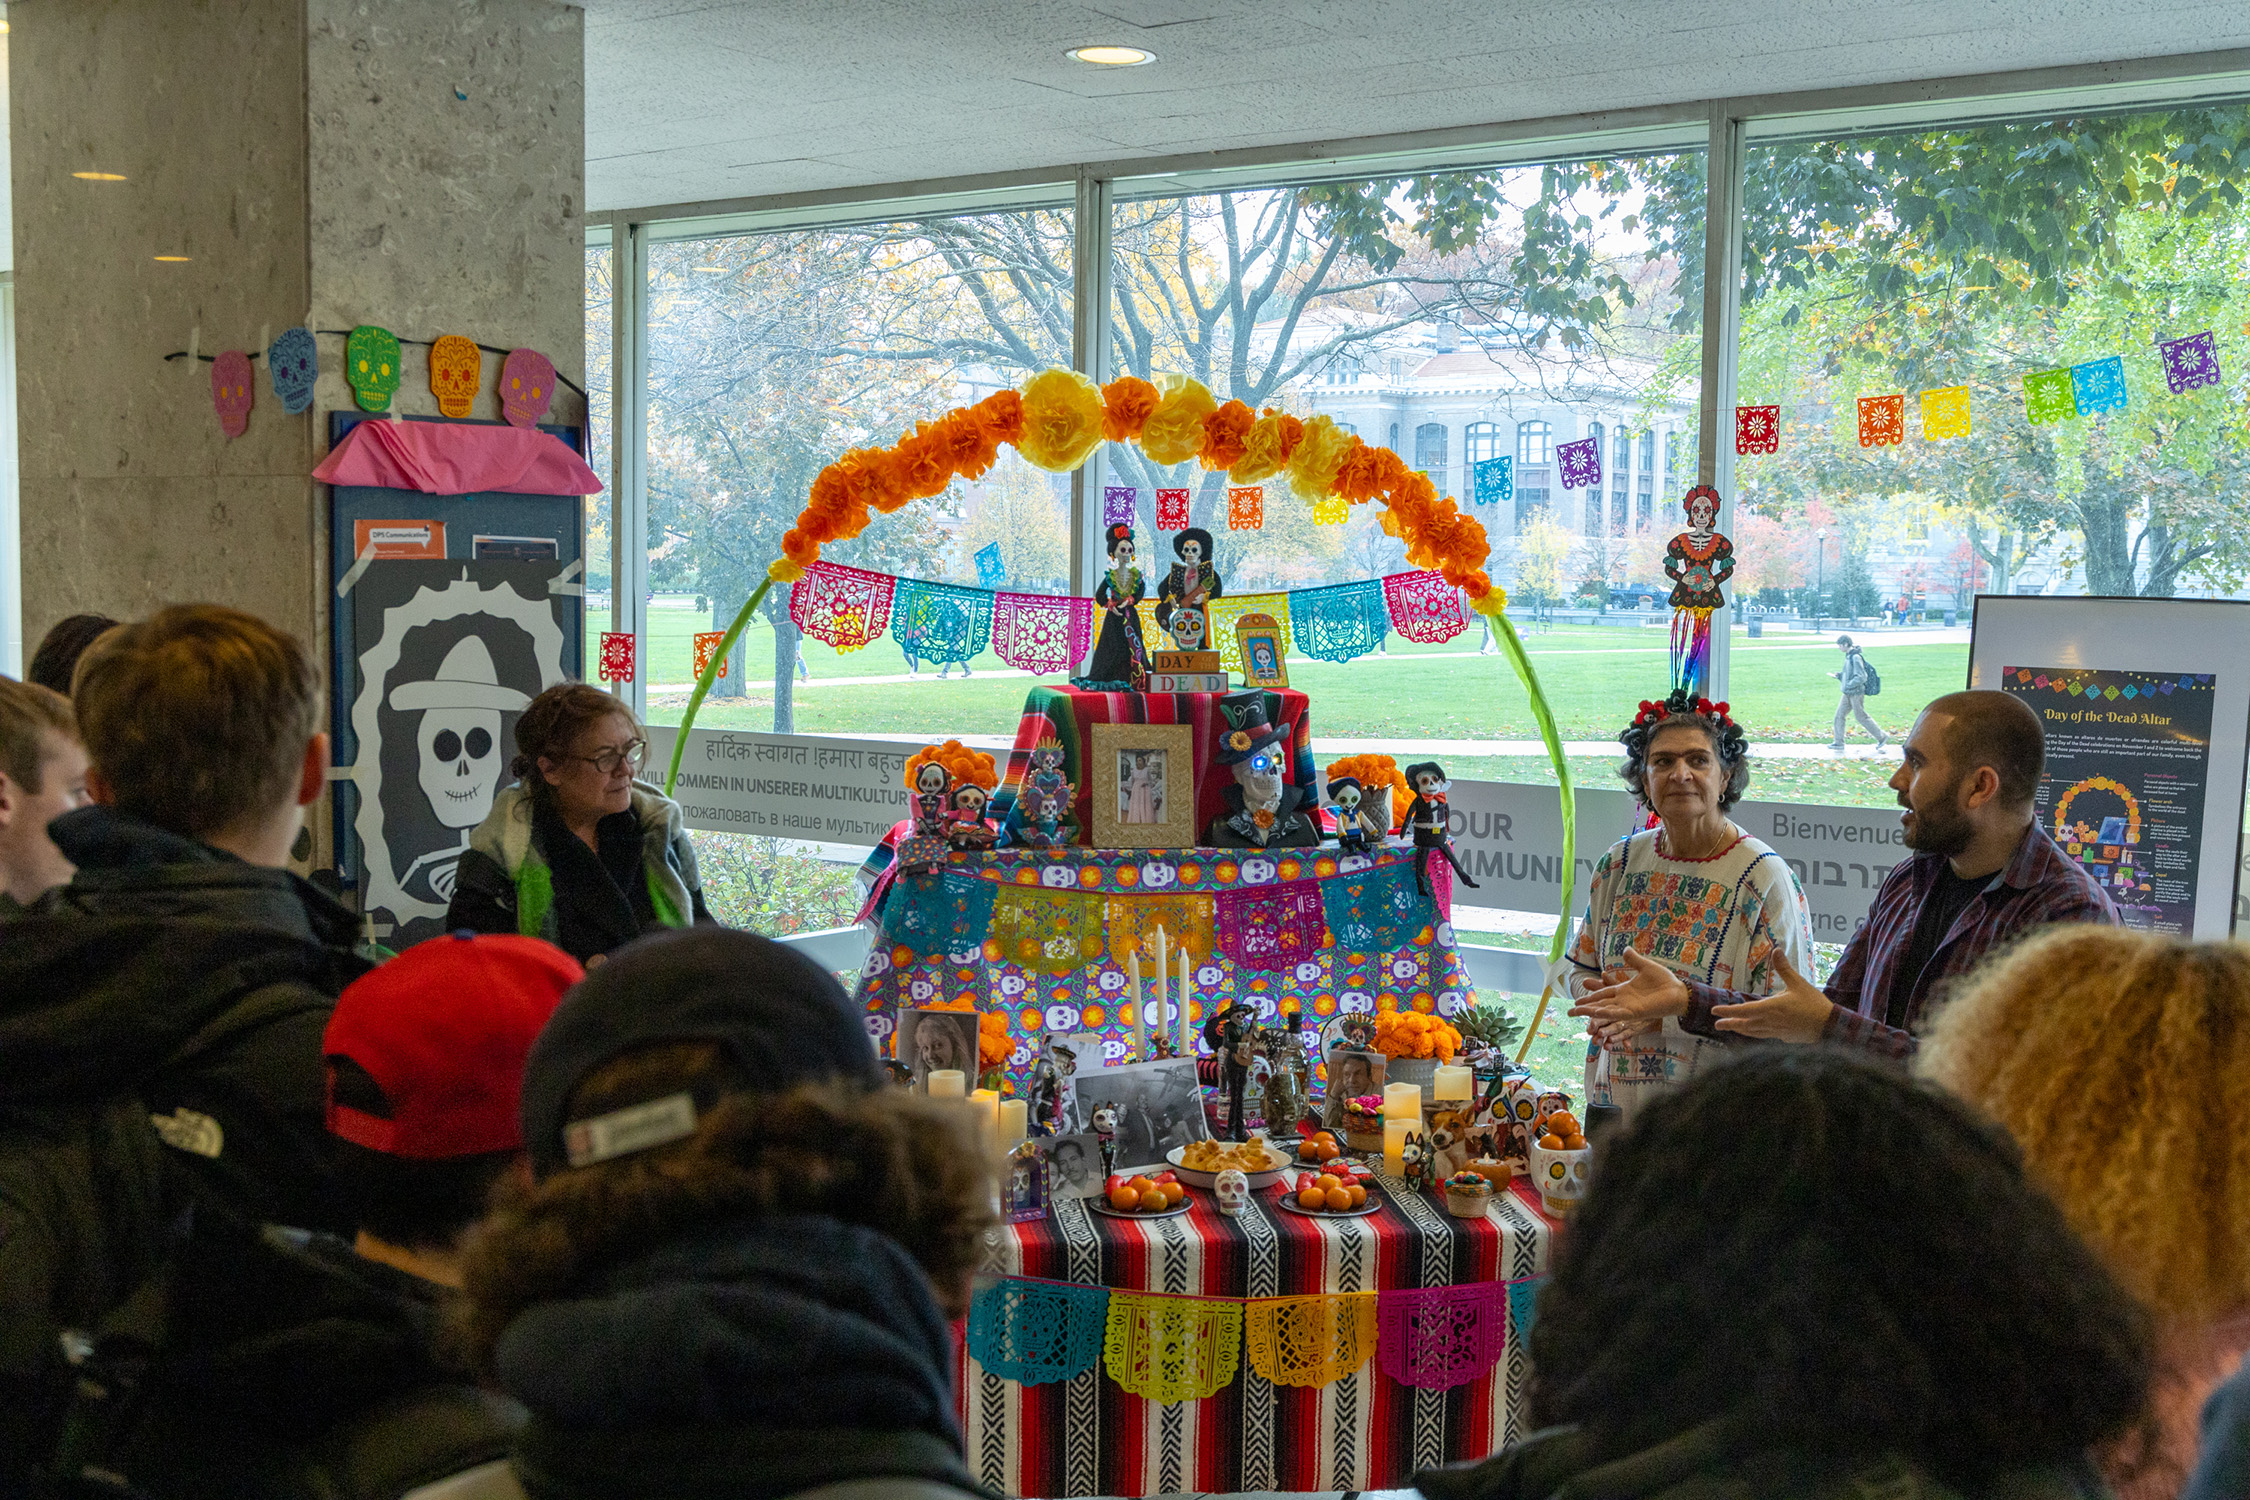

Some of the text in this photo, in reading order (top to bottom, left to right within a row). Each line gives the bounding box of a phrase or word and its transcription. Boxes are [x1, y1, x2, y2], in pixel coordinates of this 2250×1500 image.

[1160, 655, 1194, 668] DAY
[1160, 676, 1220, 692] DEAD
[2044, 708, 2172, 726] Day of the Dead Altar
[706, 734, 752, 760] हार्दिक
[754, 744, 808, 765] स्वागत
[868, 752, 912, 784] बहुज
[638, 770, 916, 806] WILLOMMEN IN UNSERER MULTIKULTUR
[683, 806, 766, 824] пожаловать
[770, 813, 778, 825] в
[783, 814, 822, 830] наше
[1449, 810, 1513, 841] OUR
[1772, 813, 1904, 846] Bienvenue
